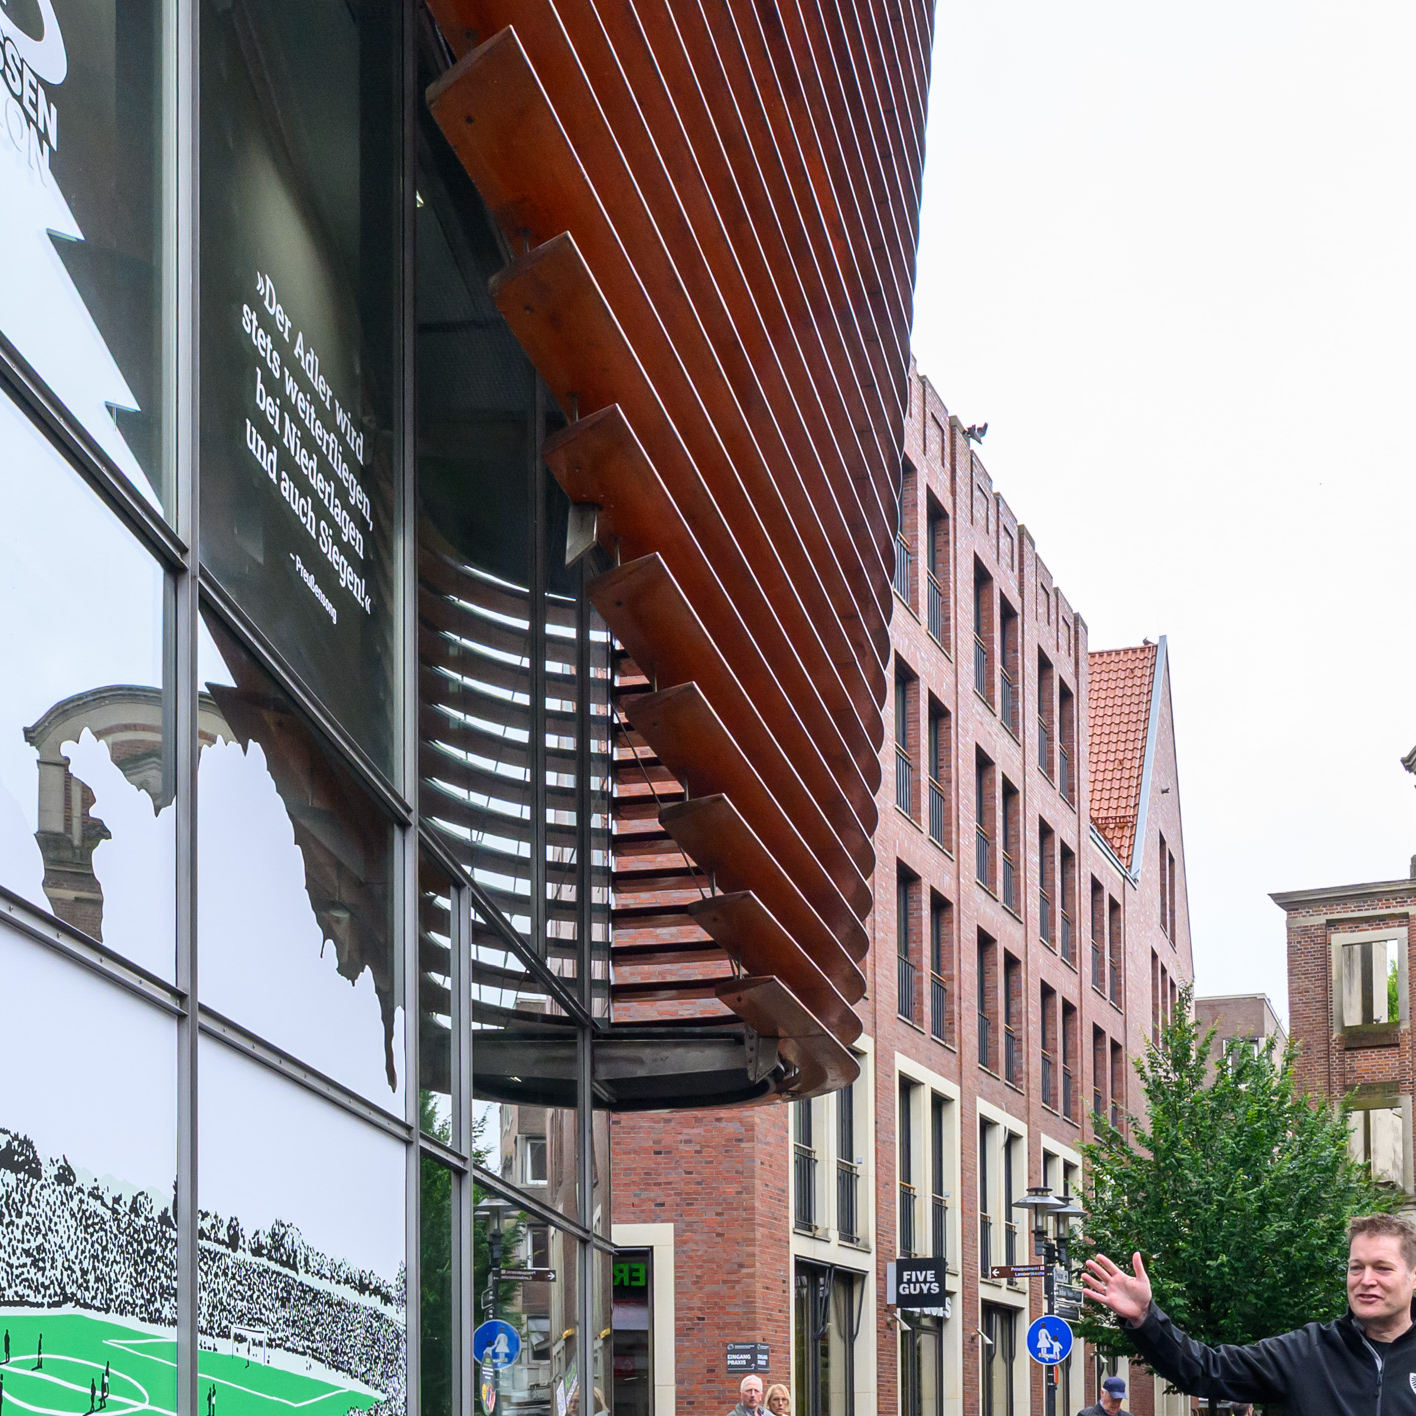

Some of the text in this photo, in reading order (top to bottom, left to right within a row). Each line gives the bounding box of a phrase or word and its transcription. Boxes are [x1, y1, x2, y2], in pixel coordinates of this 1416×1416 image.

[242, 304, 373, 531] stets weiterfliegen,
[256, 271, 364, 466] »Der Adler wird
[256, 367, 364, 559] bei Niederlagen
[246, 418, 372, 614] und auch Siegen!«
[898, 1282, 940, 1295] GUYS
[903, 1270, 936, 1282] FIVE
